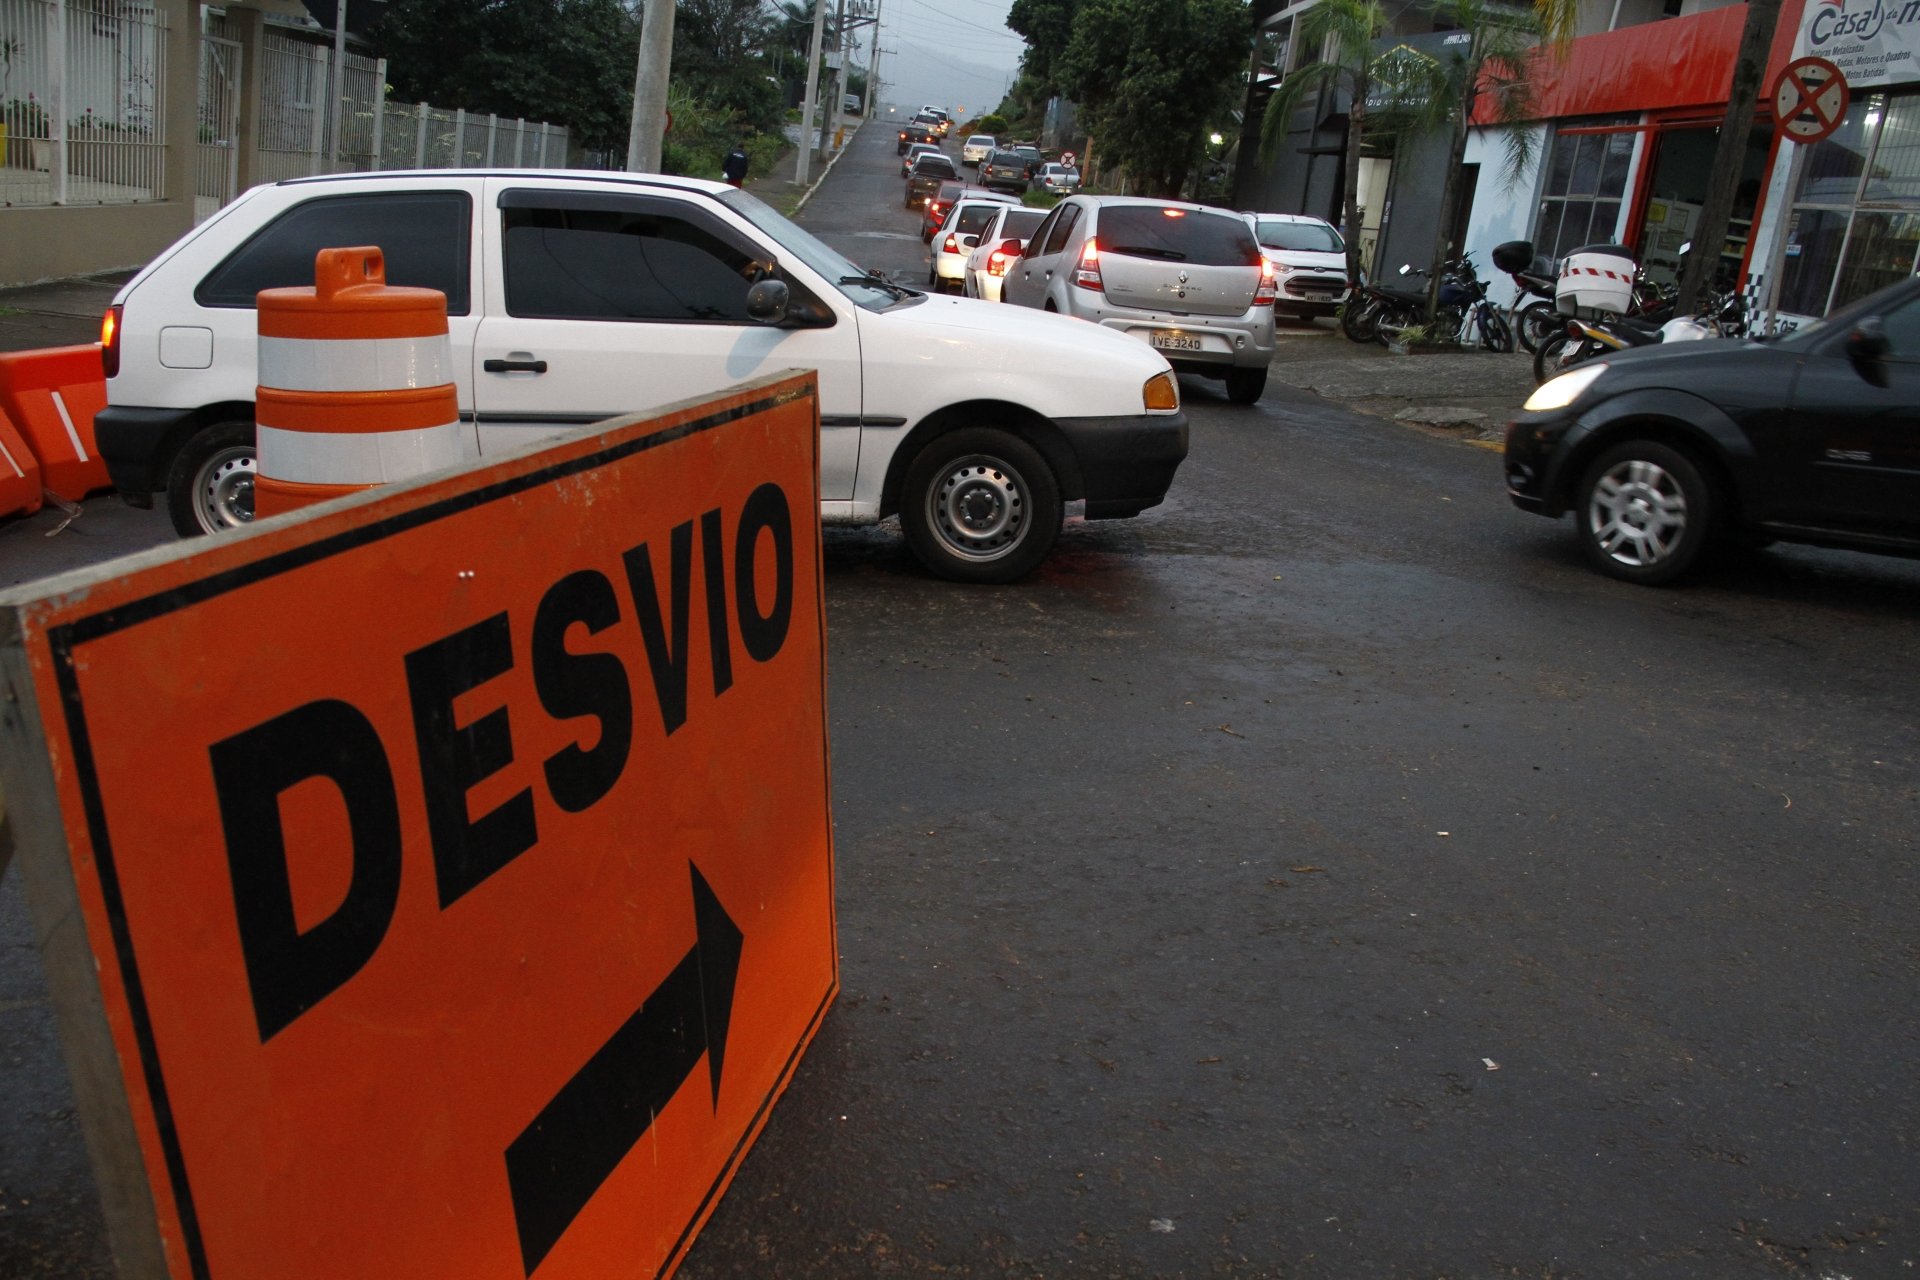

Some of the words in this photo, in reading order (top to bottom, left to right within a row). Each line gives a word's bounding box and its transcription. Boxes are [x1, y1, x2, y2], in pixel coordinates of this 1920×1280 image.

[1832, 44, 1865, 56] Metalizadas
[1856, 56, 1879, 65] Motores
[1885, 51, 1911, 62] Quadros
[1846, 70, 1862, 79] Motos
[1862, 68, 1885, 78] Batidas
[208, 482, 795, 1046] DESVIO
